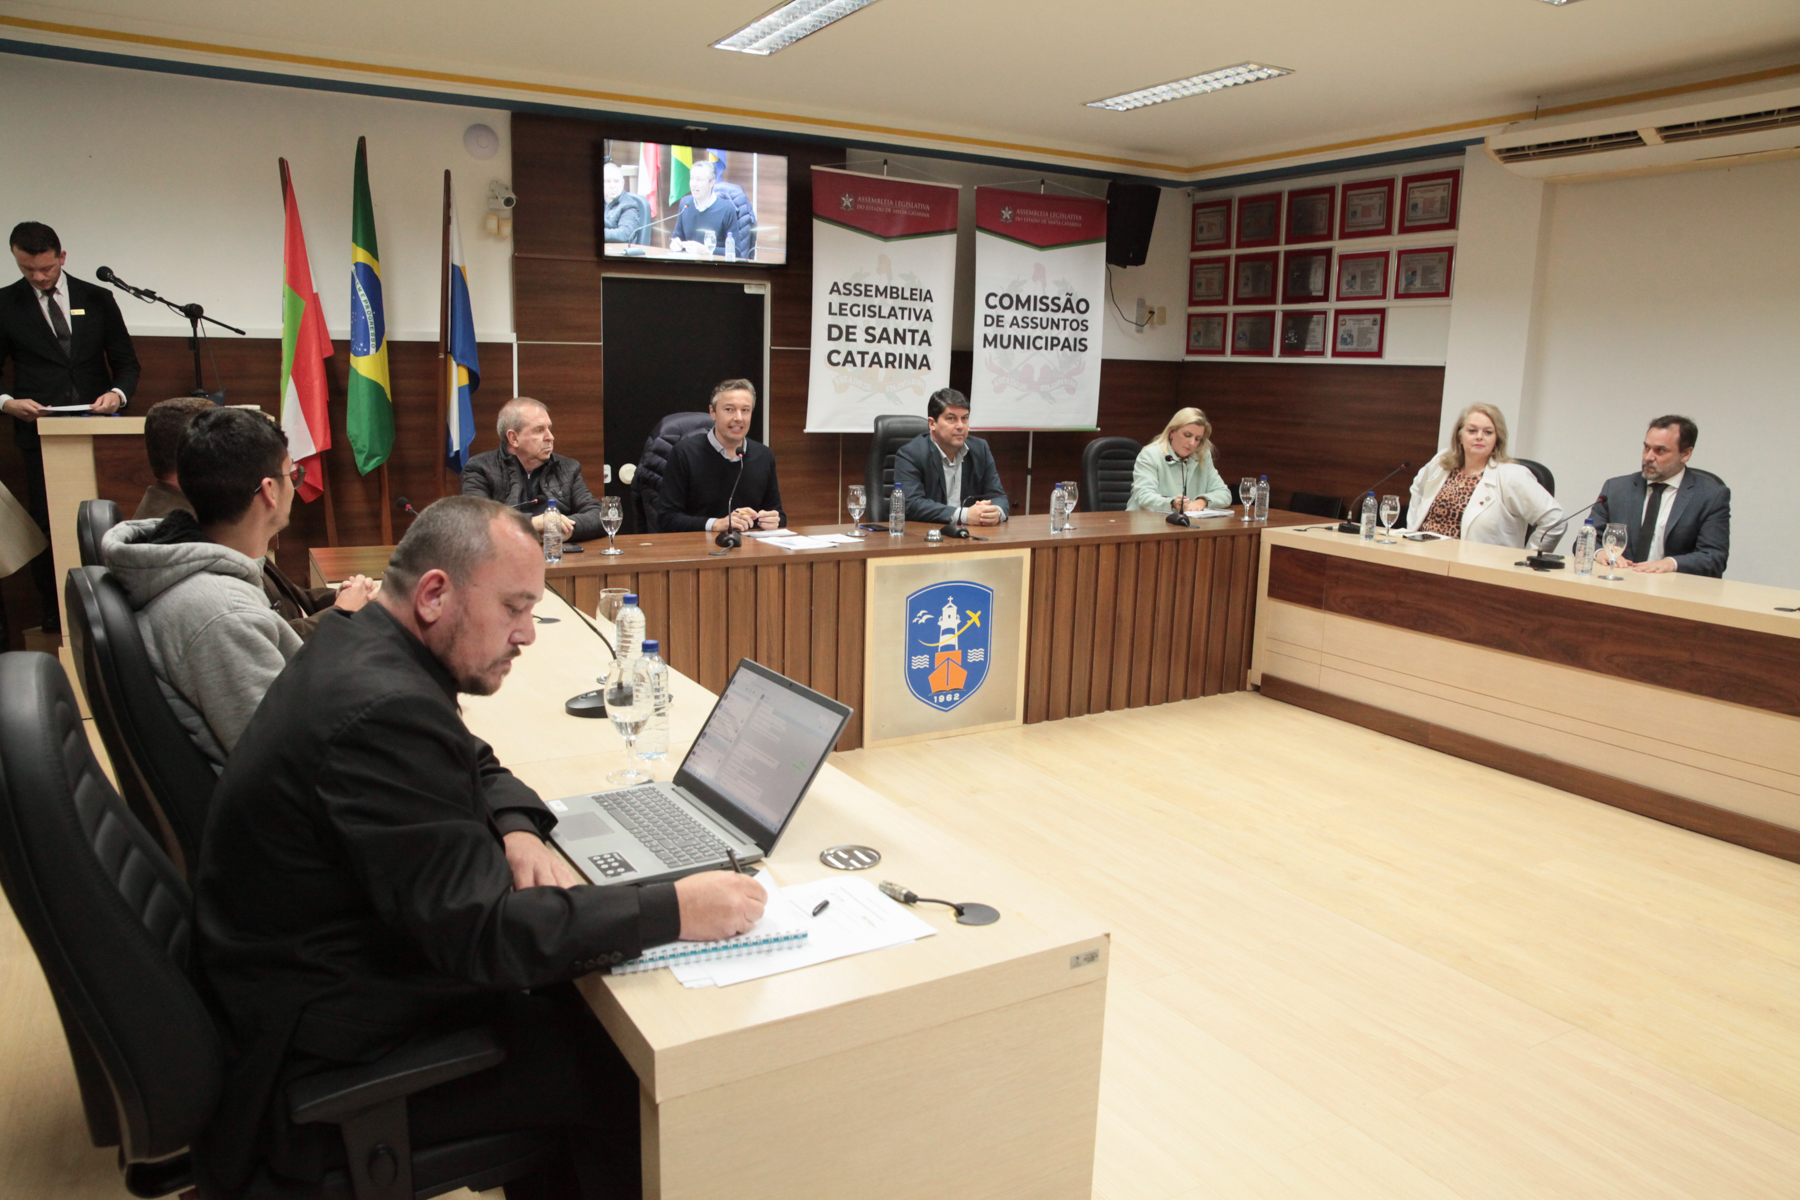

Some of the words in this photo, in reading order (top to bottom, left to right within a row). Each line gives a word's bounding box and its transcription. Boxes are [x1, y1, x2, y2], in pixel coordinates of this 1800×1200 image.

[857, 196, 894, 206] ASSEMBLEIA
[894, 200, 930, 211] LEGISLATIVA
[865, 205, 884, 213] ESTADO
[908, 210, 930, 218] CATARINA
[1016, 208, 1049, 218] ASSEMBLEIA
[1050, 211, 1082, 221] LEGISLATIVA
[828, 281, 934, 303] ASSEMBLEIA
[828, 302, 933, 323] LEGISLATIVA
[984, 292, 1090, 315] COMISSÃO
[983, 314, 1005, 328] DE
[1009, 315, 1089, 332] ASSUNTOS
[827, 323, 858, 343] DE
[864, 325, 932, 347] SANTA
[982, 333, 1088, 352] MUNICIPAIS
[826, 349, 932, 371] CATARINA
[933, 693, 960, 703] 1962
